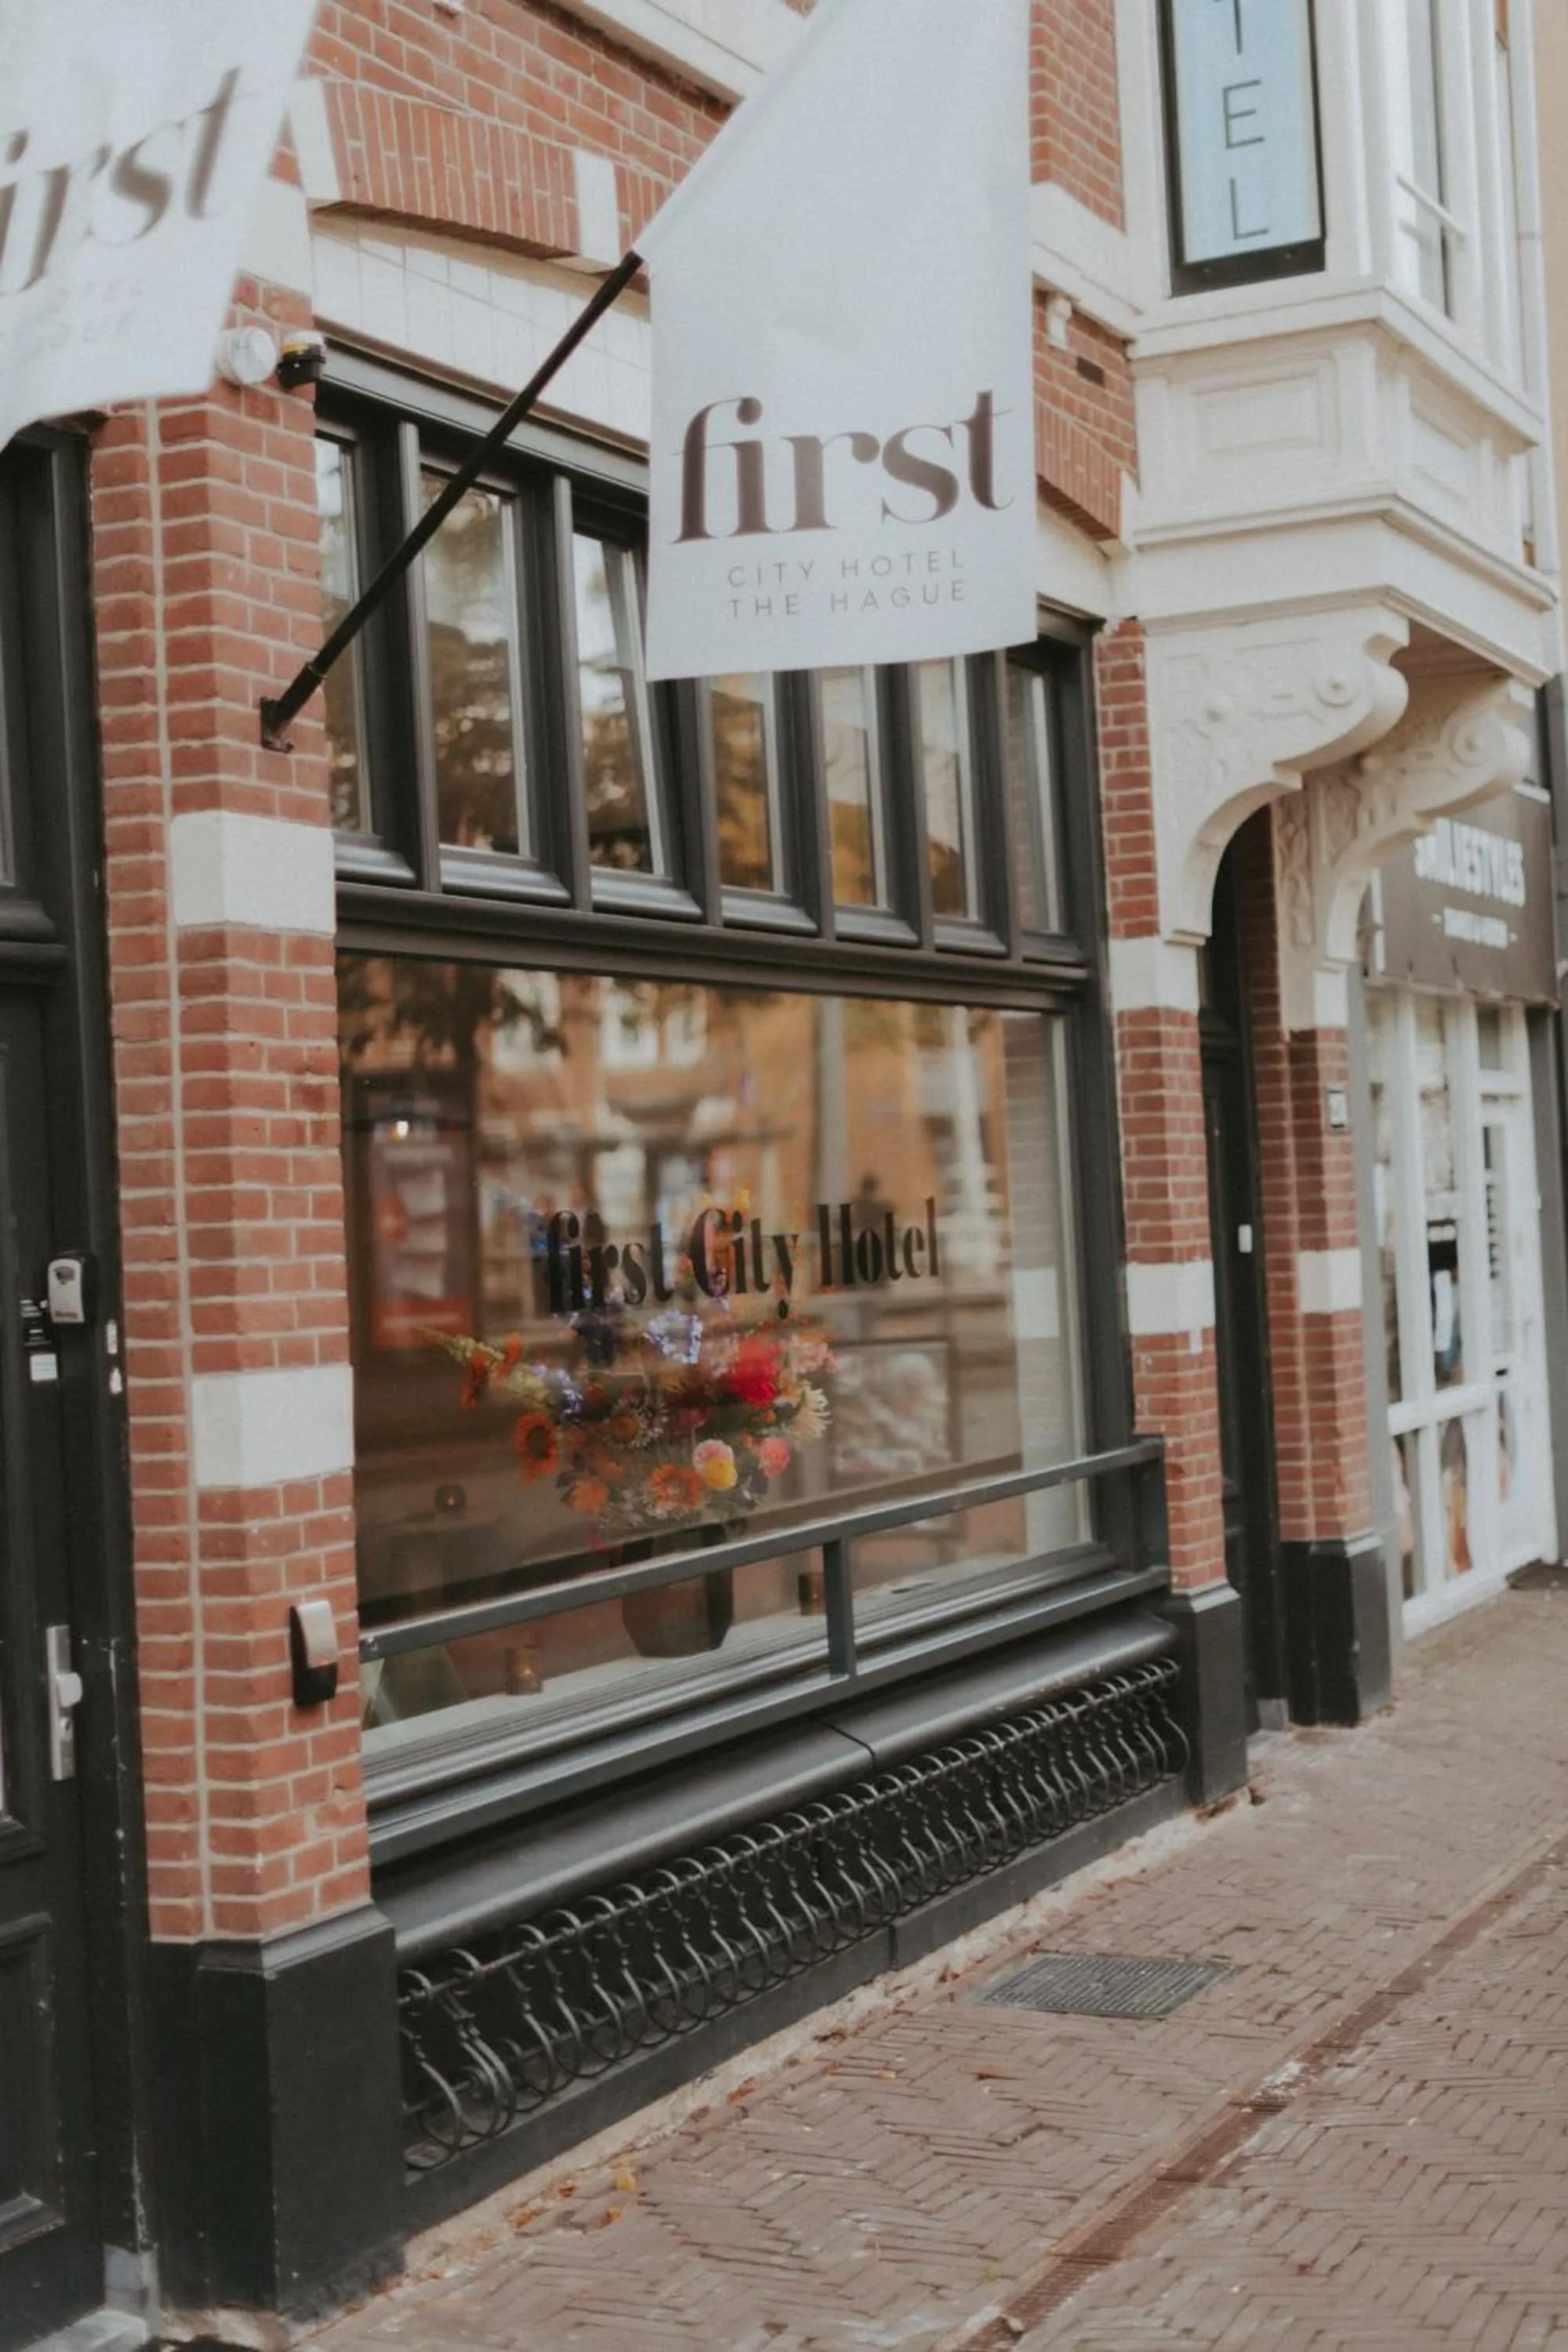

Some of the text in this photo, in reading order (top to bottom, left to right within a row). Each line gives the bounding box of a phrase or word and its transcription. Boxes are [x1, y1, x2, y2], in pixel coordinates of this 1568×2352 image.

[0, 67, 259, 293] irst
[671, 390, 1014, 545] first
[728, 550, 966, 588] CITY HOTEL
[729, 580, 966, 619] THE HAGUE
[548, 1196, 940, 1320] first City Hotel
